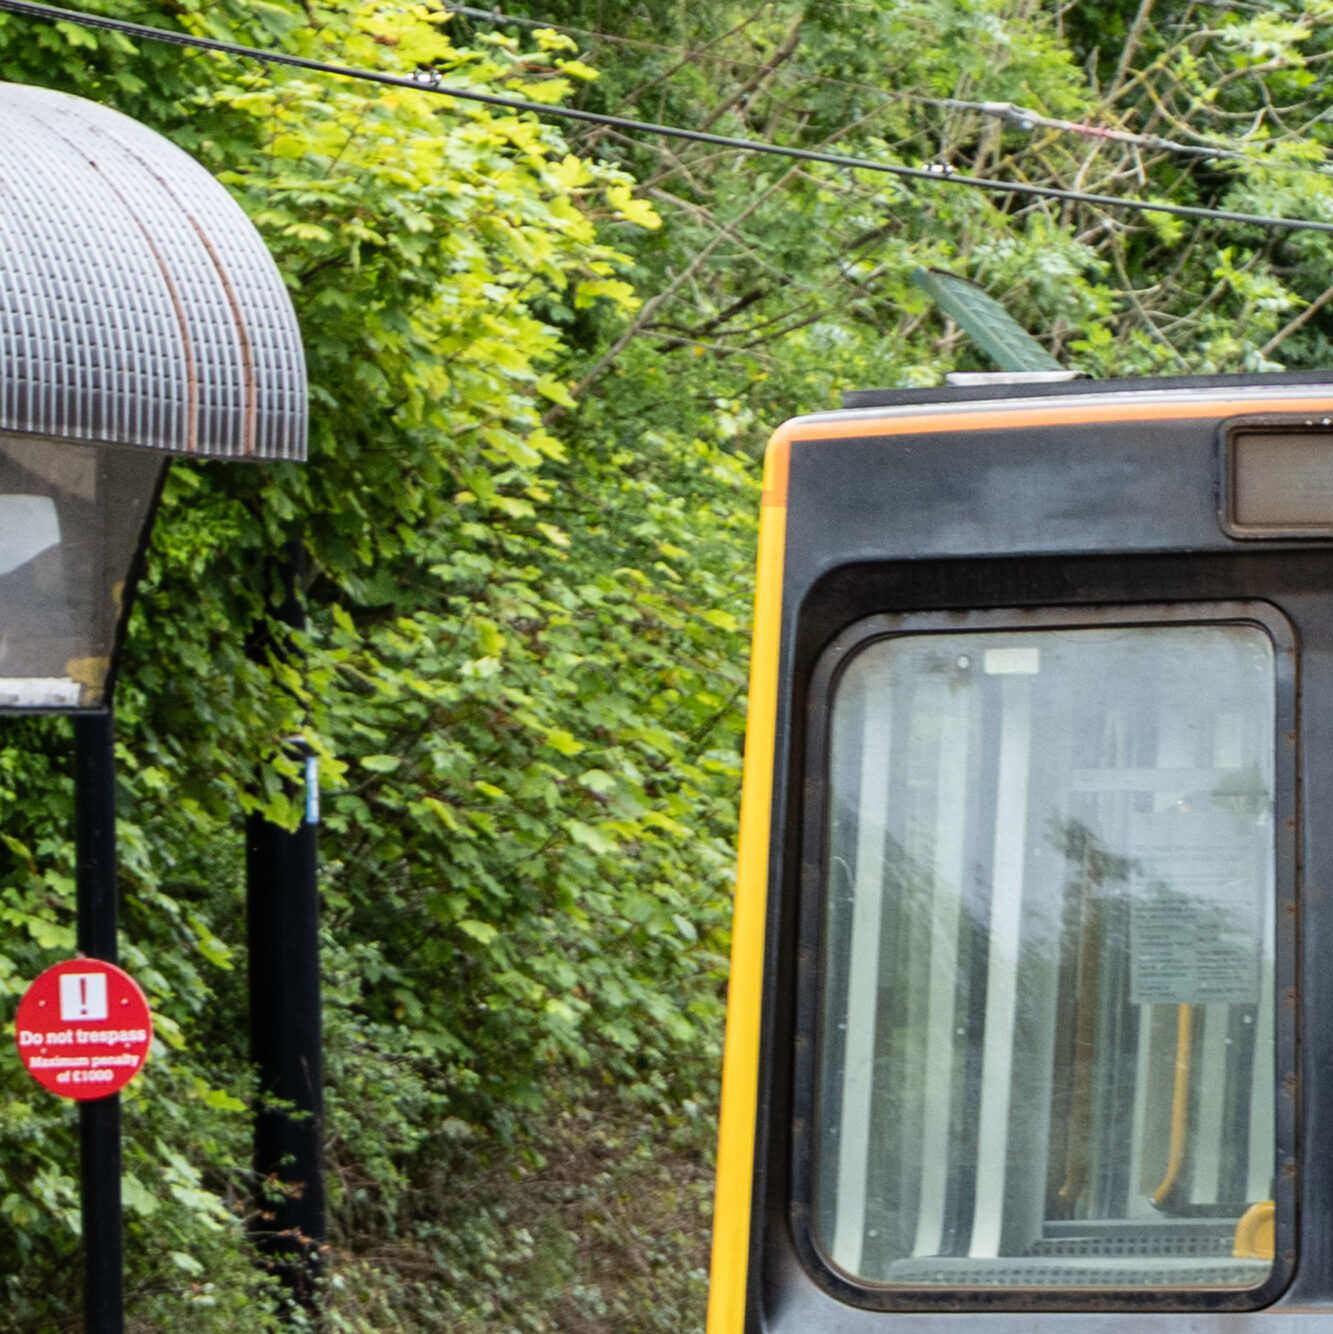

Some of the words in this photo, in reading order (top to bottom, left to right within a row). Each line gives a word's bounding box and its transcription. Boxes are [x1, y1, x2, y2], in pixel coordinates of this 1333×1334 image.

[20, 1031, 43, 1045] Do
[46, 1029, 73, 1044] not
[77, 1029, 147, 1045] trespass
[30, 1057, 89, 1067] Maximum
[91, 1054, 140, 1068] penalty
[57, 1071, 71, 1082] of
[73, 1070, 114, 1082] £1000
